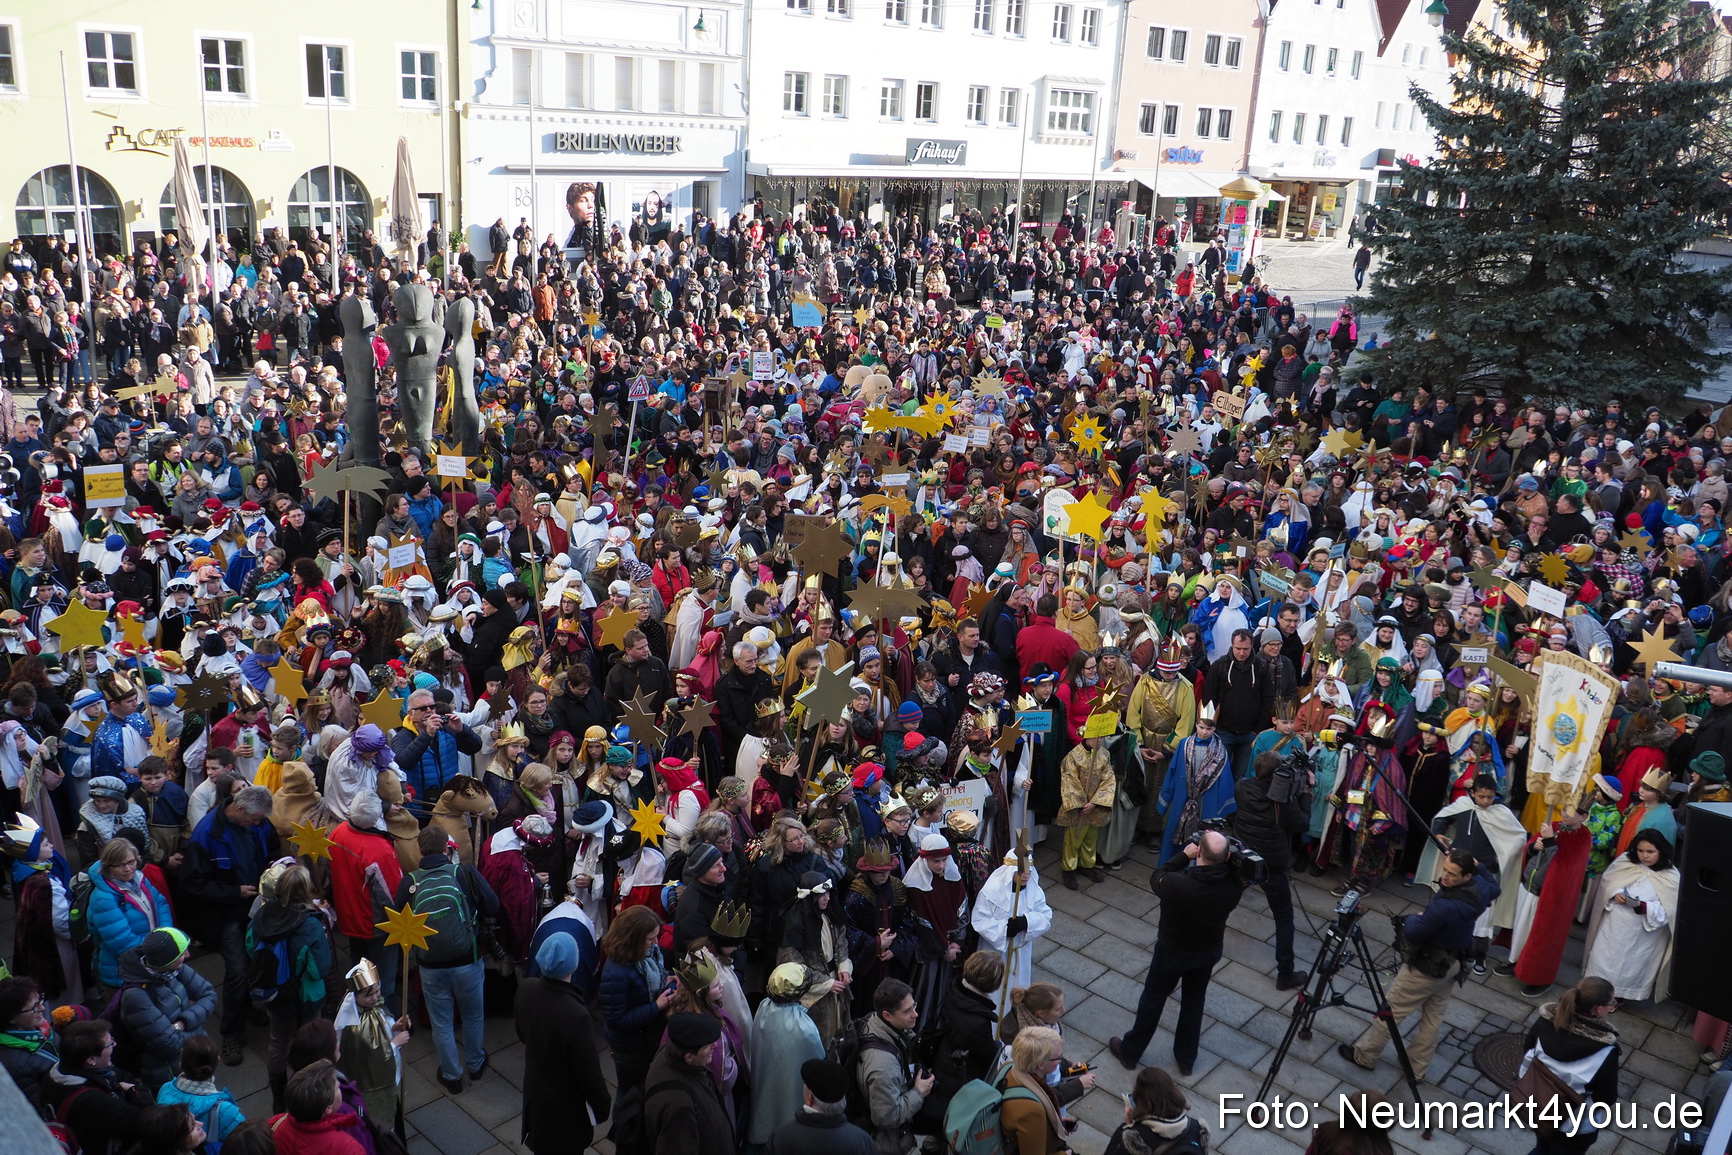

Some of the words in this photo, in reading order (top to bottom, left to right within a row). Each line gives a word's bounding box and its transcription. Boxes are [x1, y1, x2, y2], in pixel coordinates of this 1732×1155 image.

[555, 131, 621, 151] BRILLEN
[625, 134, 683, 153] WEBER
[909, 140, 966, 164] frühauf
[1261, 577, 1286, 592] Traunfeld
[1579, 678, 1603, 705] Kinder
[944, 795, 973, 809] Georg
